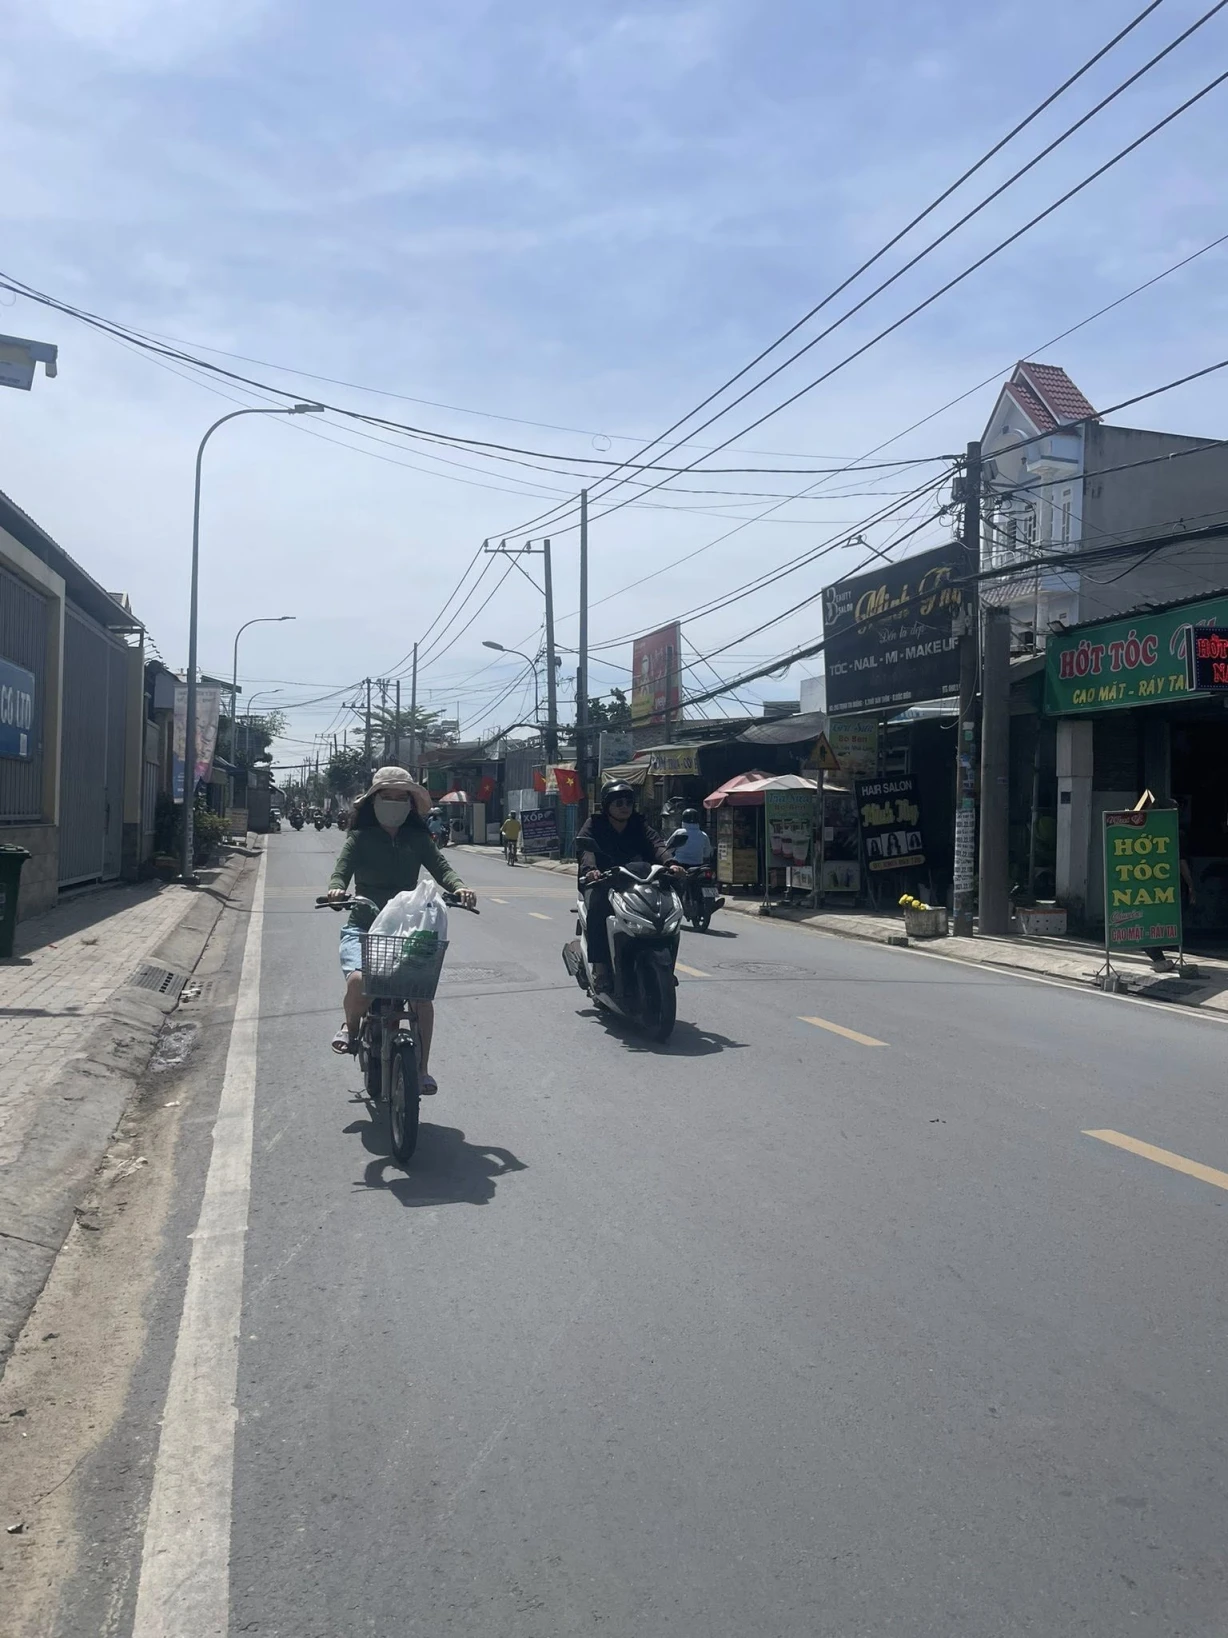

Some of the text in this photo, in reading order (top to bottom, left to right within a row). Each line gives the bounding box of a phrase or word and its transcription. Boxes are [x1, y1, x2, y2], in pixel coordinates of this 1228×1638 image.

[829, 660, 848, 676] TÓC
[854, 656, 878, 672] NAIL
[885, 650, 898, 665] MI
[1059, 640, 1105, 680] HỚT
[1108, 628, 1159, 672] TÓC
[1072, 688, 1094, 706] CẠO
[1098, 681, 1127, 703] MẶT
[1138, 675, 1164, 697] RÁY
[16, 690, 32, 730] LTD
[861, 780, 913, 797] HAIR SALON
[523, 811, 543, 823] XỐP
[1114, 833, 1170, 856] HỚT
[1115, 859, 1170, 882] TÓC
[1112, 886, 1175, 906] NAM
[1127, 924, 1145, 943] MẶT
[1150, 923, 1165, 939] RÁY
[1166, 925, 1178, 938] TAI
